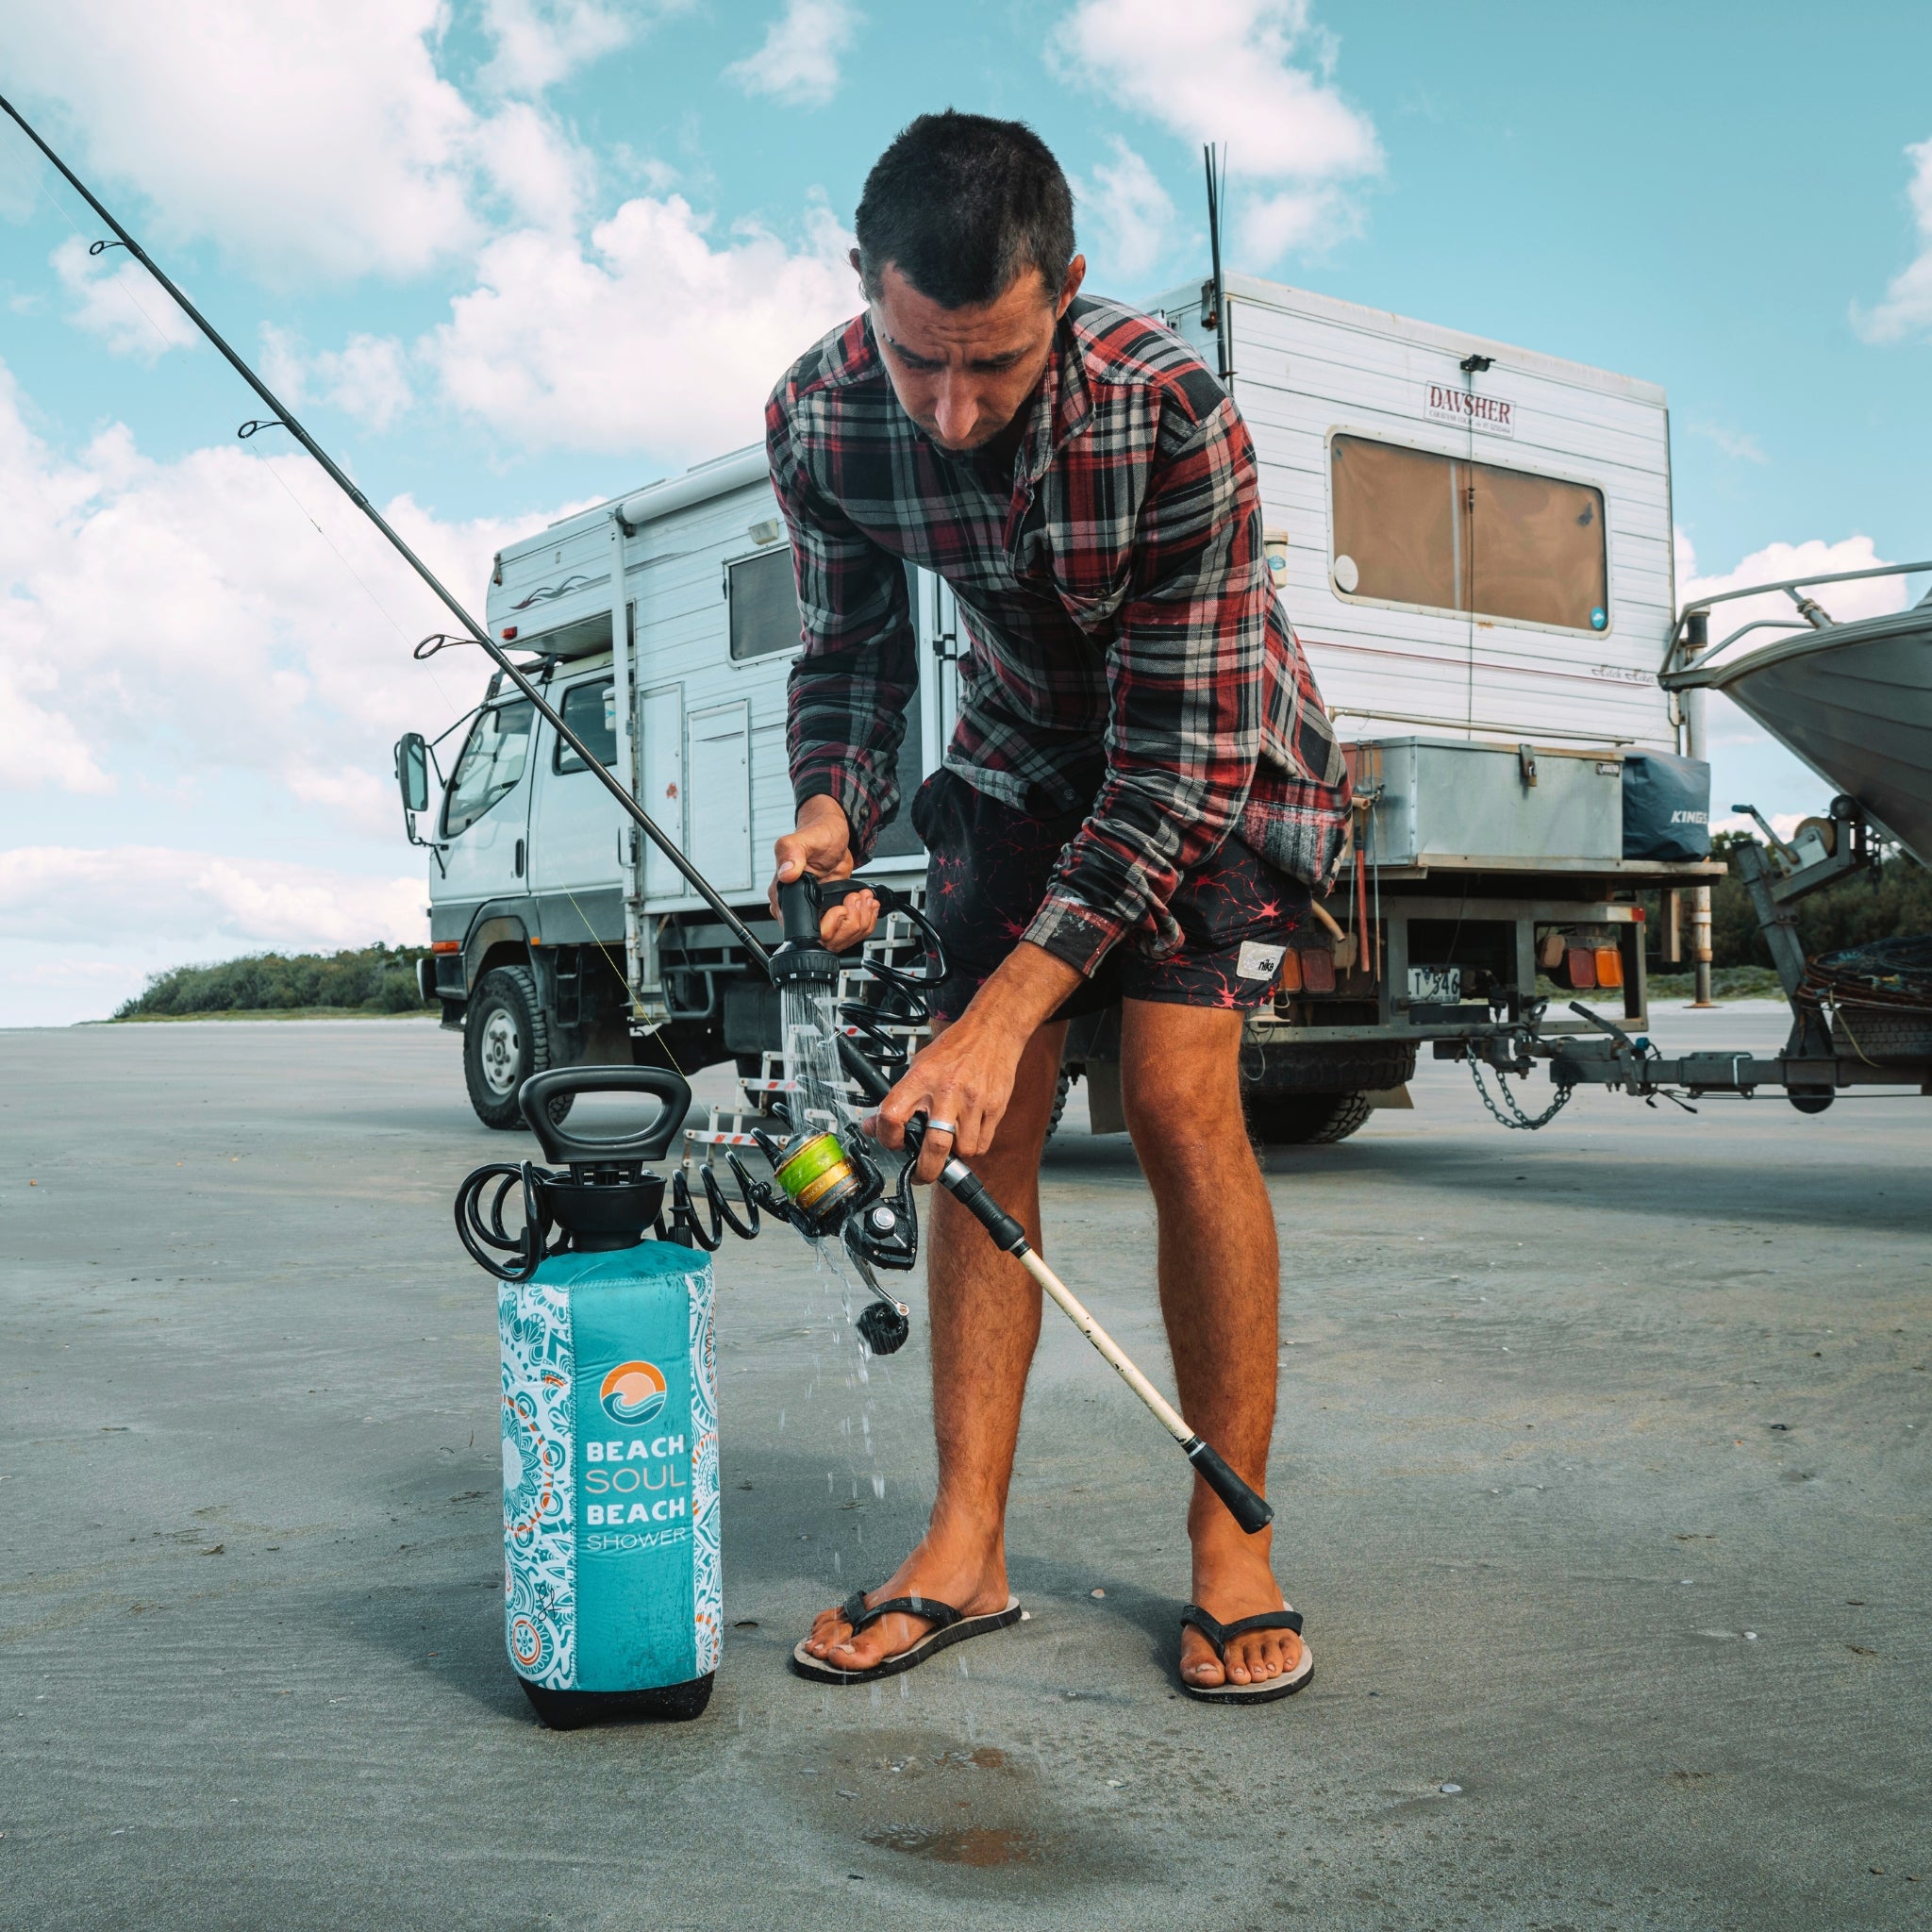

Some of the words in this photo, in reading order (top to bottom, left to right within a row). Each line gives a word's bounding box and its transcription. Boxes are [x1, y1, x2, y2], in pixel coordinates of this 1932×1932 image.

[1430, 386, 1510, 425] DAVSHER
[1671, 810, 1708, 824] KINGS
[586, 1434, 684, 1462] BEACH
[585, 1464, 686, 1494] SOUL
[587, 1497, 685, 1525] BEACH
[587, 1527, 686, 1550] SHOWER
